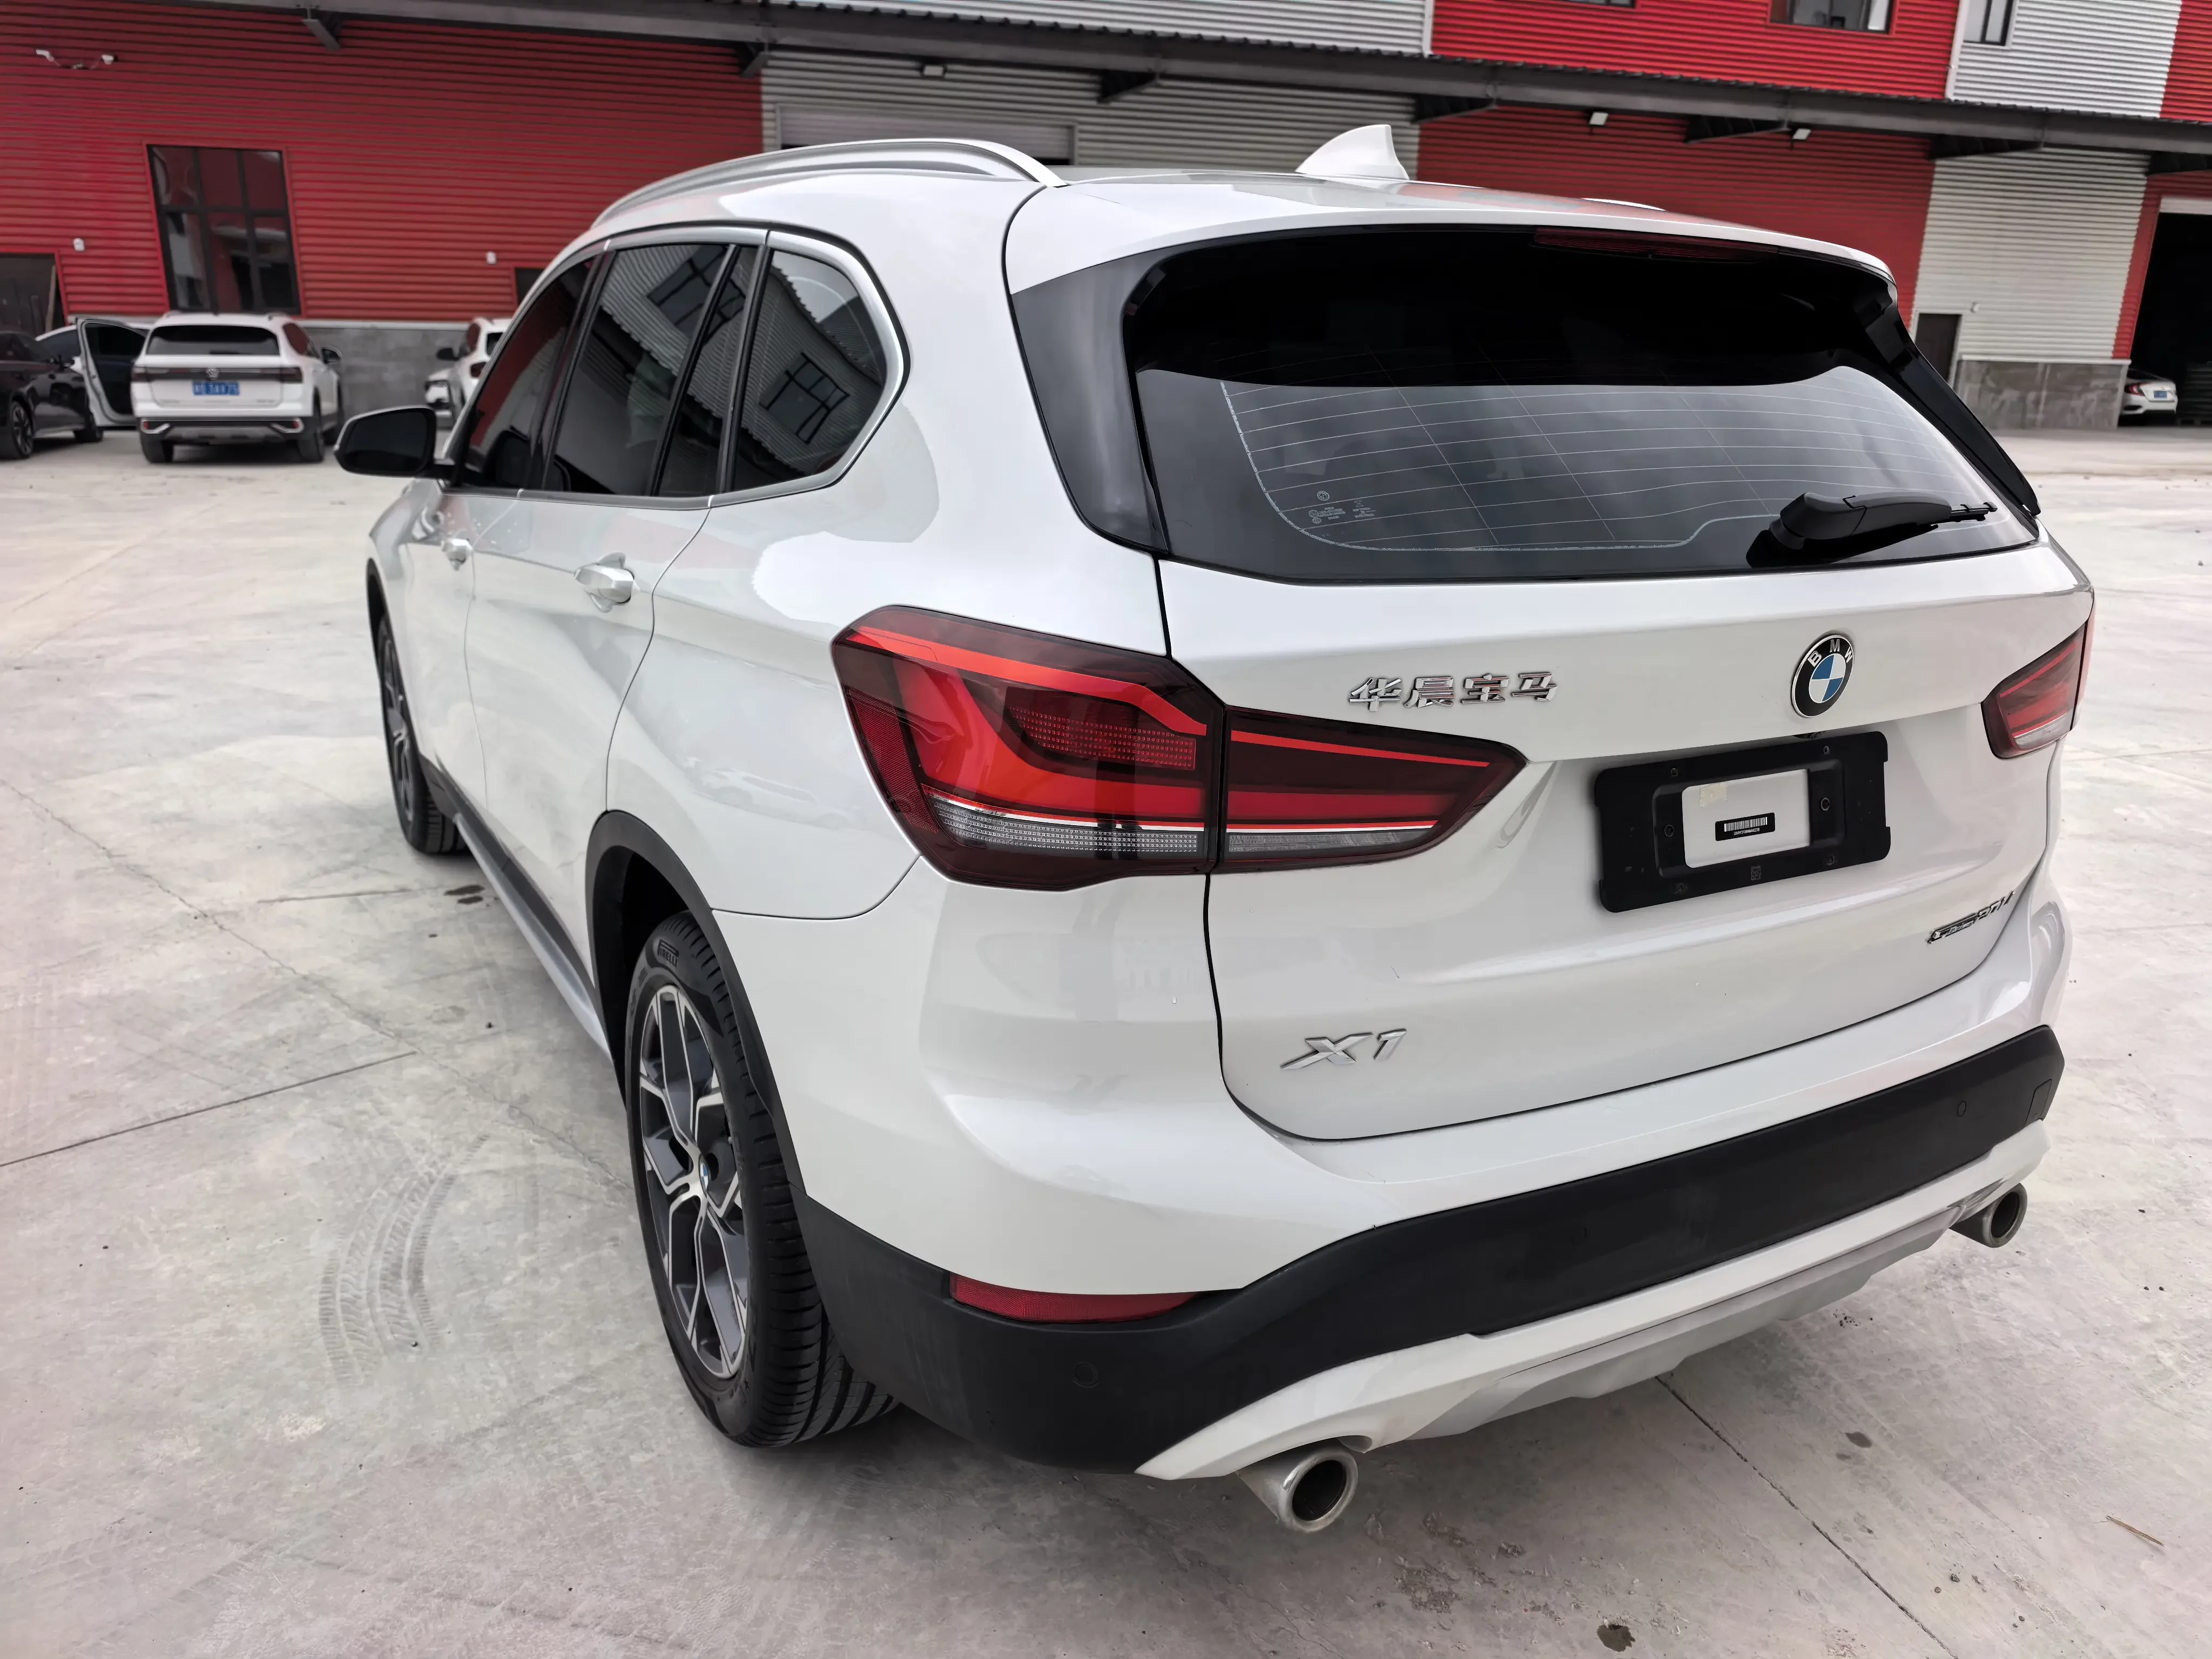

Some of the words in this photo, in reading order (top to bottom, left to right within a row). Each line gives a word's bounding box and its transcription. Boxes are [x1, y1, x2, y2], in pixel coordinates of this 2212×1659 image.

[1808, 639, 1852, 667] BMW
[1349, 672, 1557, 712] 华晨宝马
[657, 939, 679, 967] PIRELLI
[1280, 1028, 1407, 1069] X1
